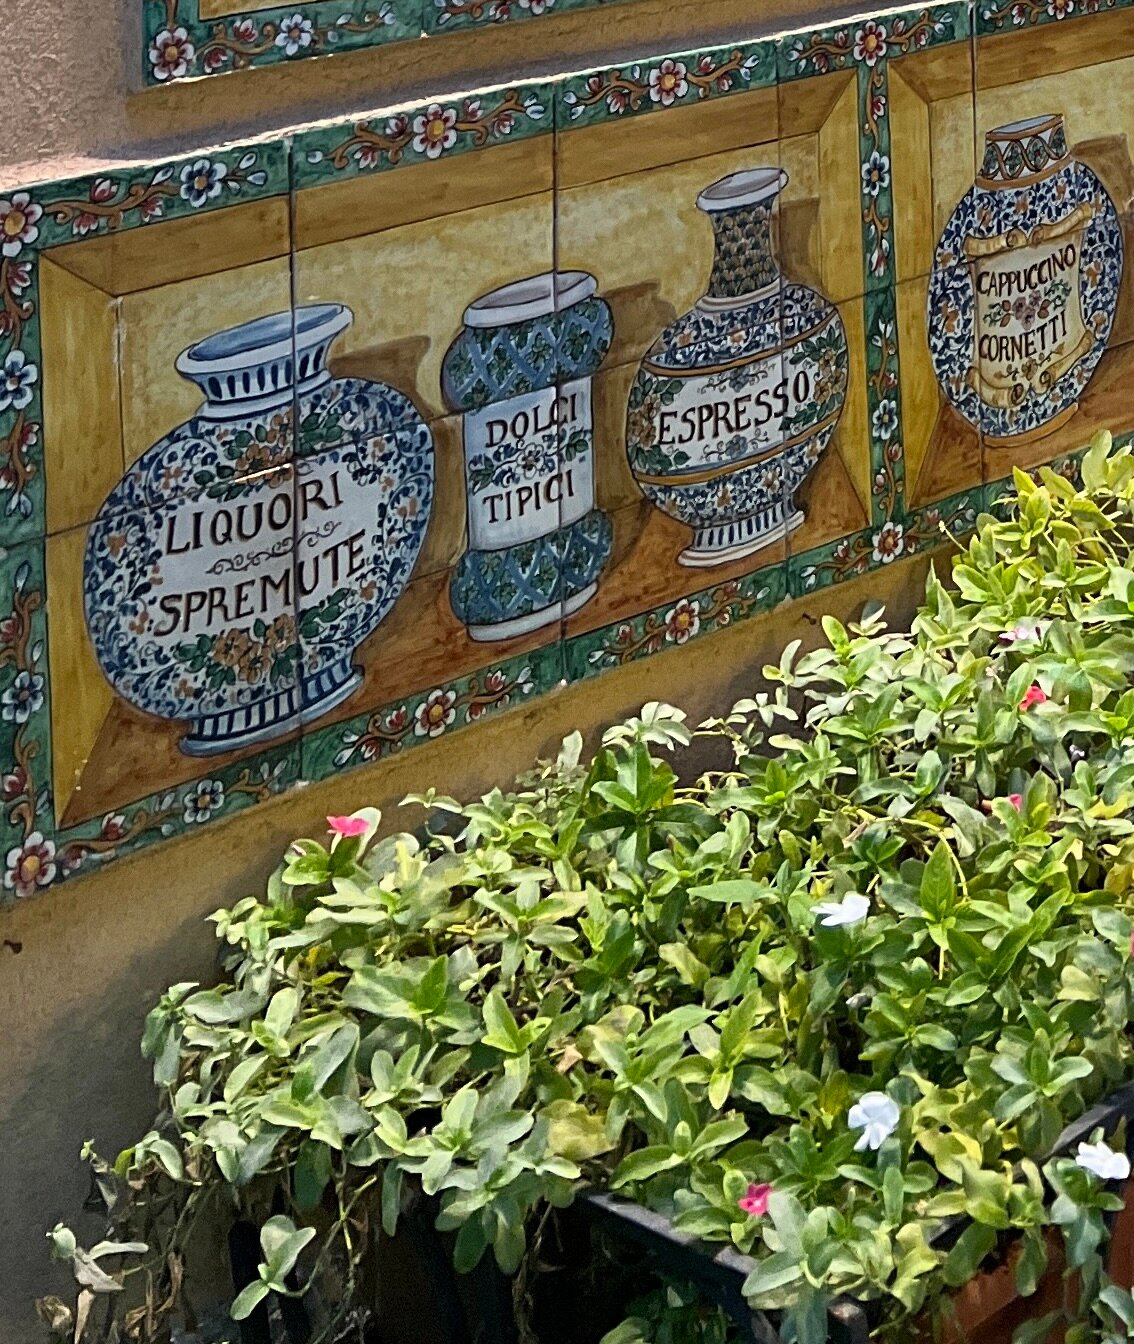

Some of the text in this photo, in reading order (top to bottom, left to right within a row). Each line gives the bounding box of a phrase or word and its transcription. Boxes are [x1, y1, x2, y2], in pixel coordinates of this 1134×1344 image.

[976, 243, 1077, 298] CAPPUCCINO
[979, 310, 1068, 362] CORNETTI
[484, 393, 579, 449] DOLCI
[657, 371, 812, 446] ESPRESSO
[165, 469, 345, 557] LIQUORI
[483, 468, 576, 524] TIPICI
[155, 528, 367, 638] SPREMUTE
